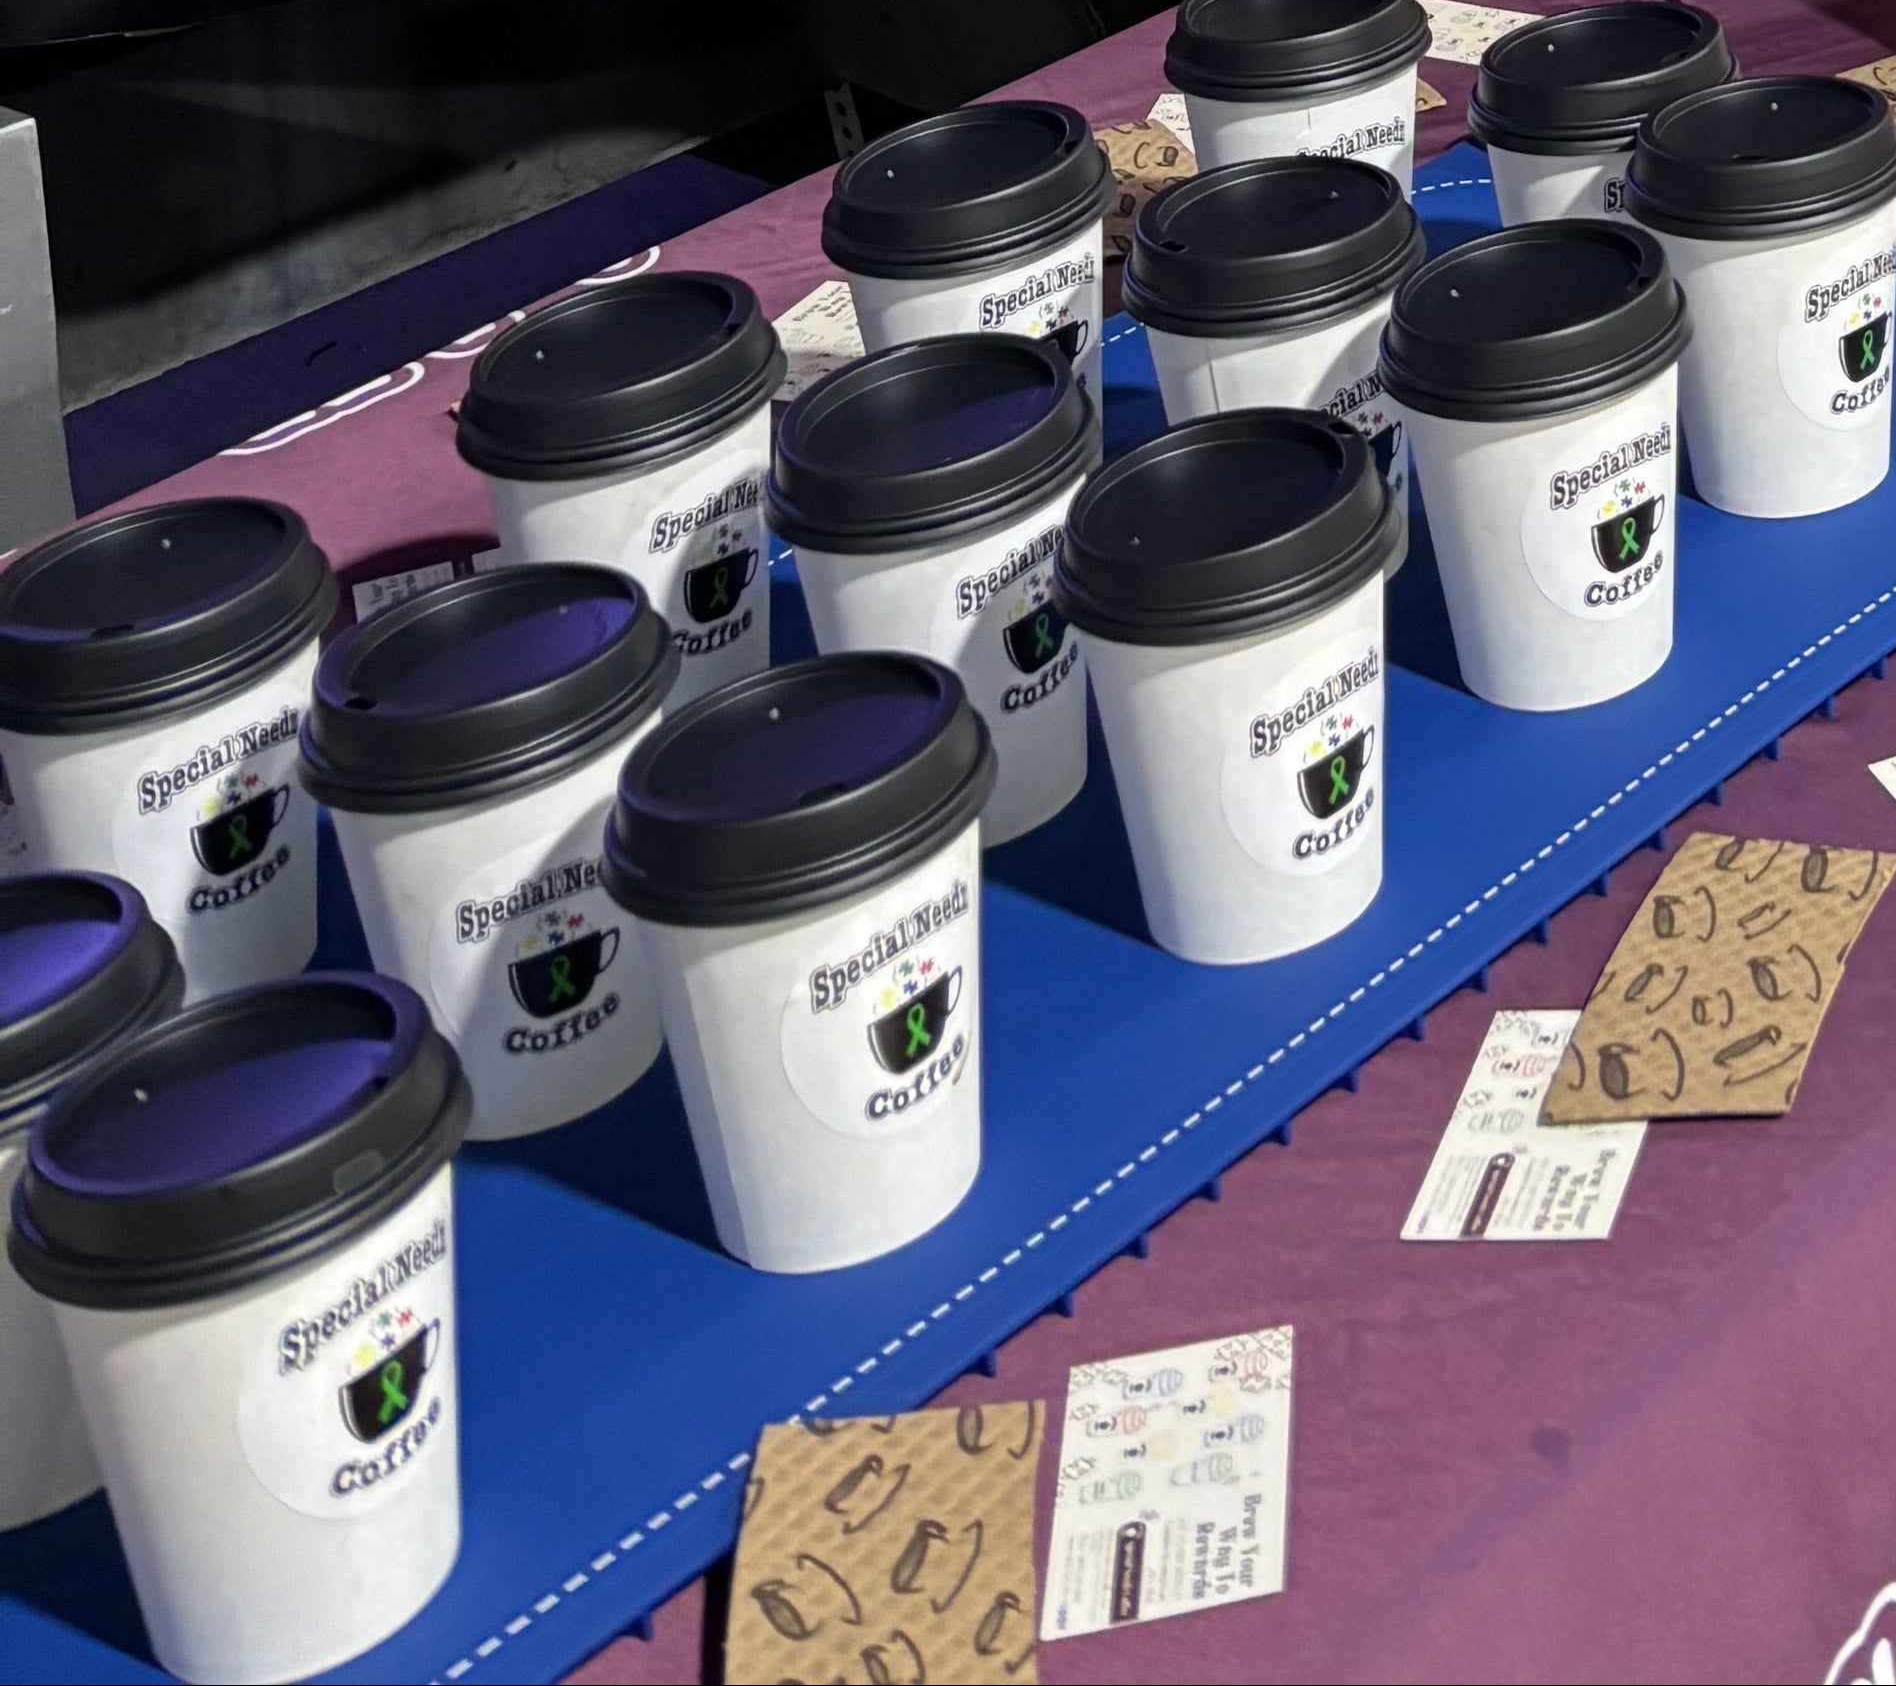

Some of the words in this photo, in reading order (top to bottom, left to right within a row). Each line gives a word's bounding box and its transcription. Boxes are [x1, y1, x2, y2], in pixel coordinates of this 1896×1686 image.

[979, 272, 1053, 330] Special
[1804, 265, 1873, 323] Special
[1830, 365, 1890, 415] Coffee
[1550, 443, 1631, 511] Special
[648, 485, 734, 554] Special
[956, 538, 1038, 619] Special
[1583, 549, 1664, 609] Coffee
[1001, 641, 1079, 715] Coffee
[1250, 677, 1337, 757] Special
[138, 732, 236, 815] Special
[1292, 786, 1375, 861] Coffee
[187, 846, 292, 914] Coffee
[455, 865, 563, 942] Special
[810, 919, 914, 1013] Special
[503, 990, 622, 1057] Coffee
[864, 1032, 966, 1123] Coffee
[278, 1259, 390, 1377] Special
[330, 1395, 443, 1499] Coffee
